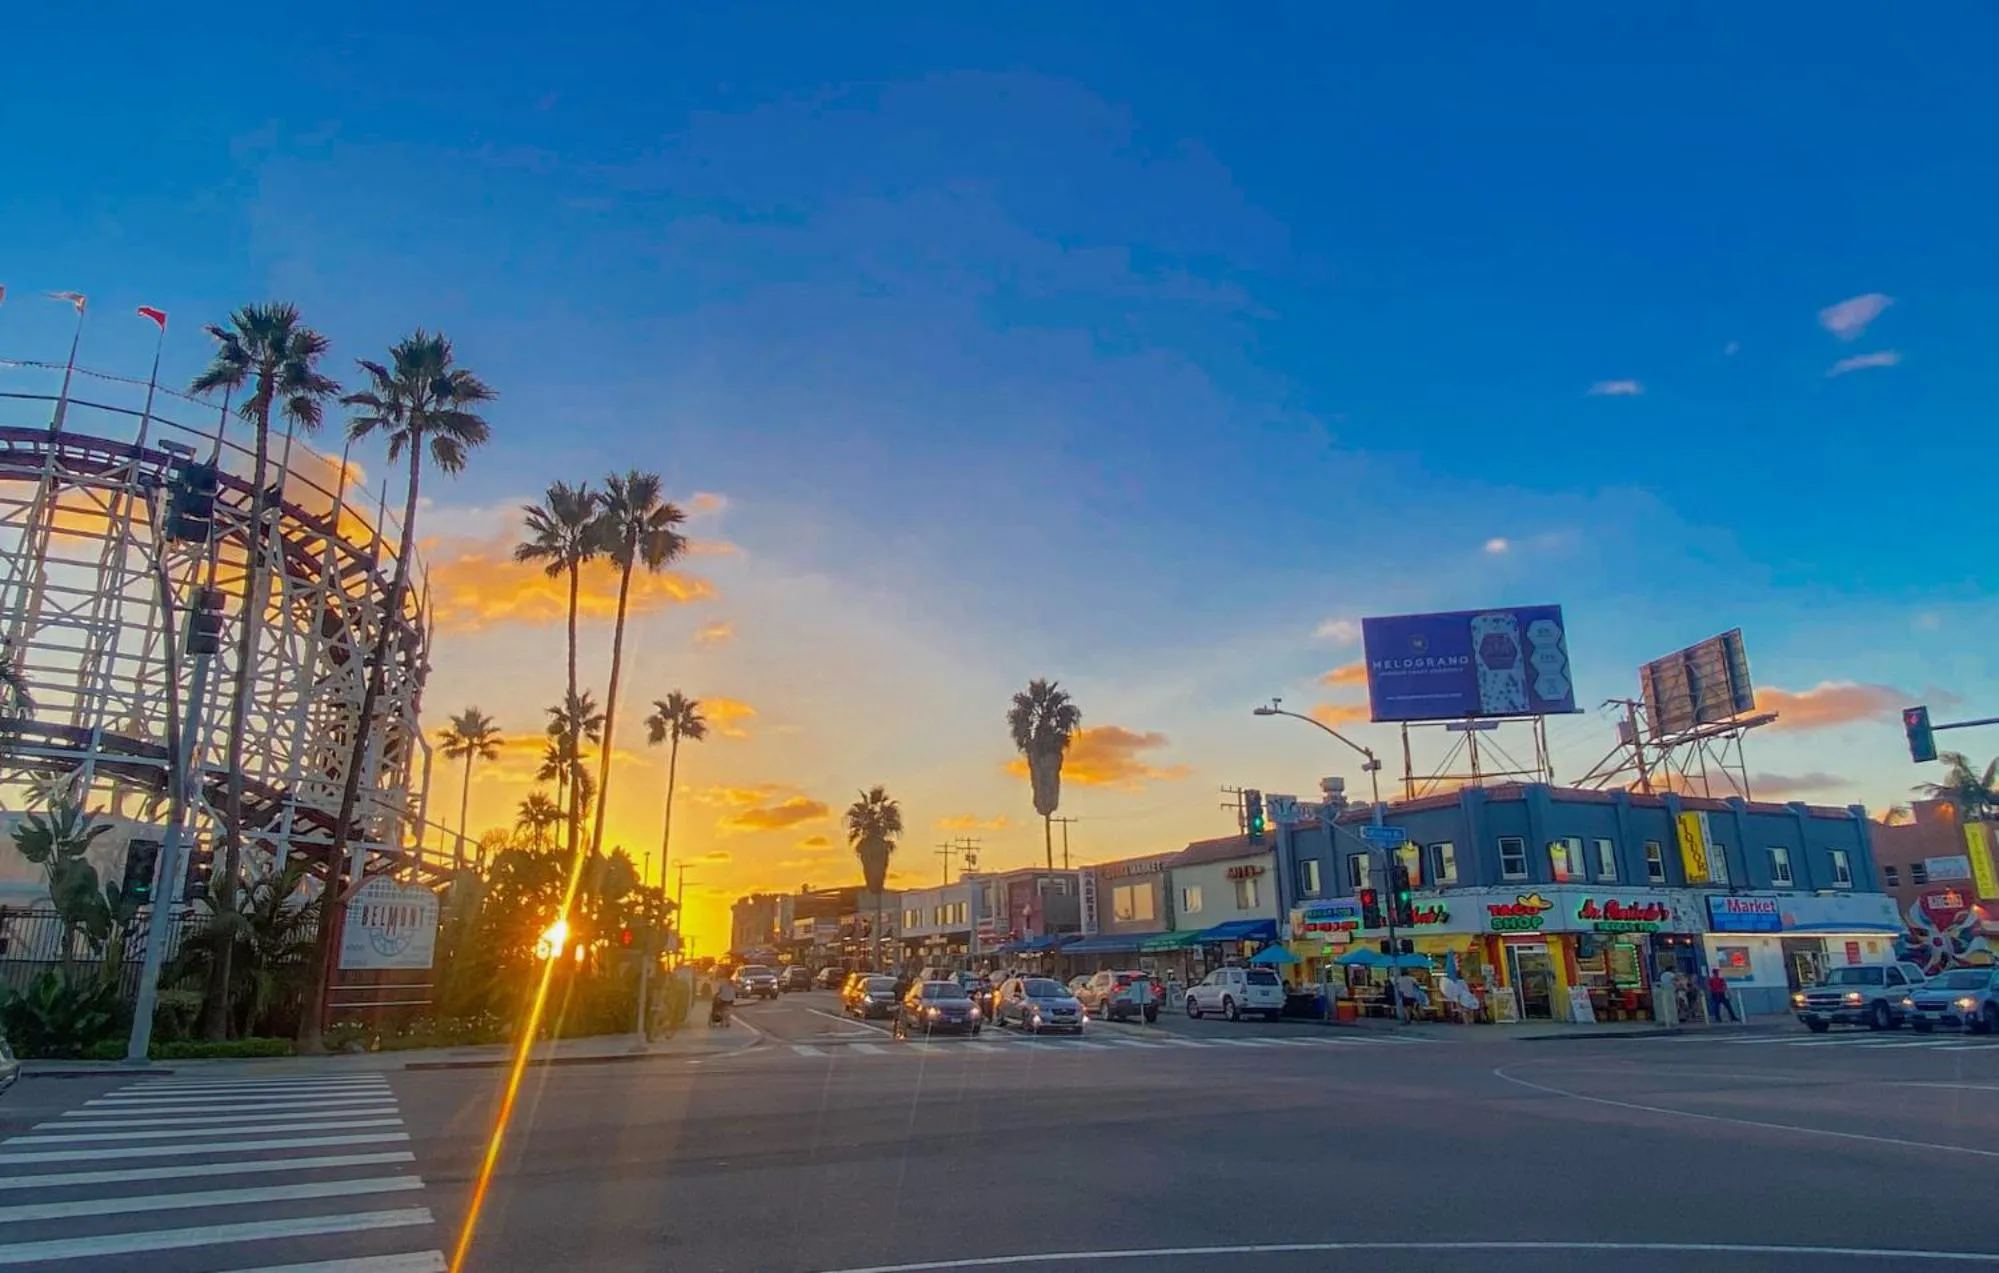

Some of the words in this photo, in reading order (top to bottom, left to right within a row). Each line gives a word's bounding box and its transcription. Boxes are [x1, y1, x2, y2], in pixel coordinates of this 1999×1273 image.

[1373, 656, 1469, 669] MELOGRANO
[1487, 904, 1540, 916] TACO
[1727, 896, 1776, 913] Market
[361, 905, 425, 936] BELMONT
[1491, 916, 1544, 930] SHOP
